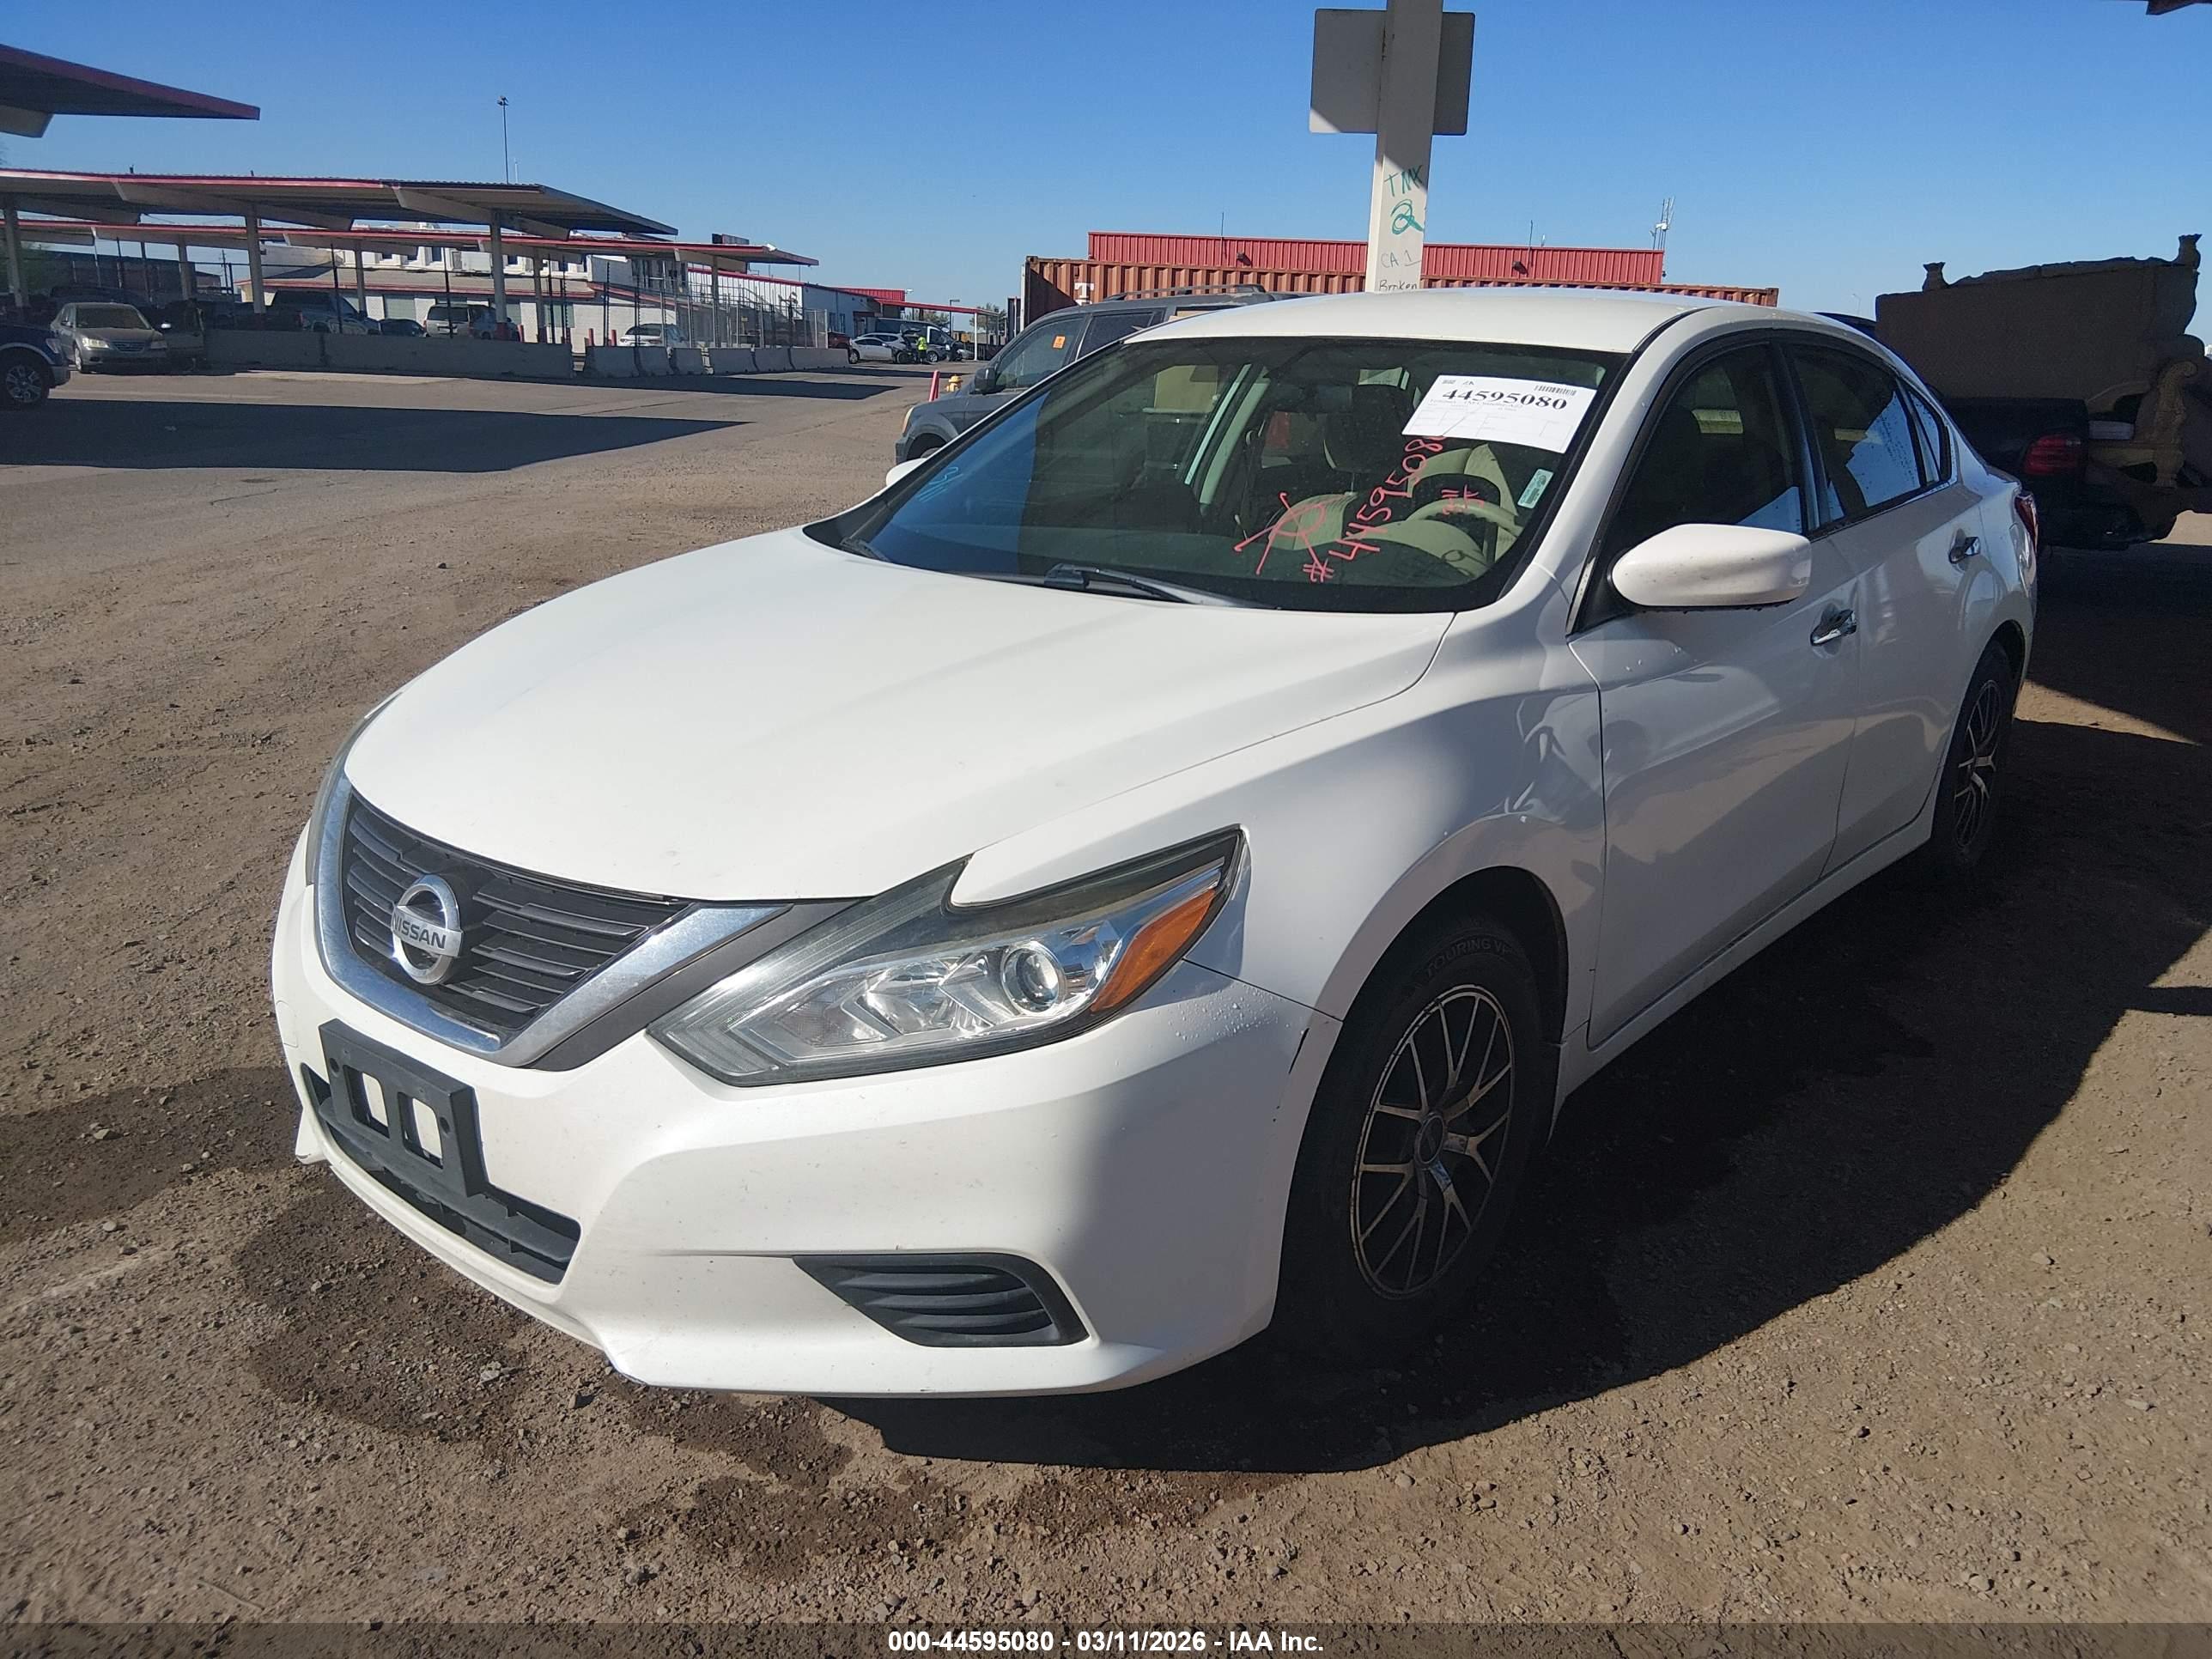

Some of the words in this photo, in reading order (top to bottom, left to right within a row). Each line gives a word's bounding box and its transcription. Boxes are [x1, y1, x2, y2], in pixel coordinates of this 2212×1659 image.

[1390, 198, 1425, 235] 2
[1443, 389, 1567, 410] 44595080
[393, 913, 446, 949] NISSAN
